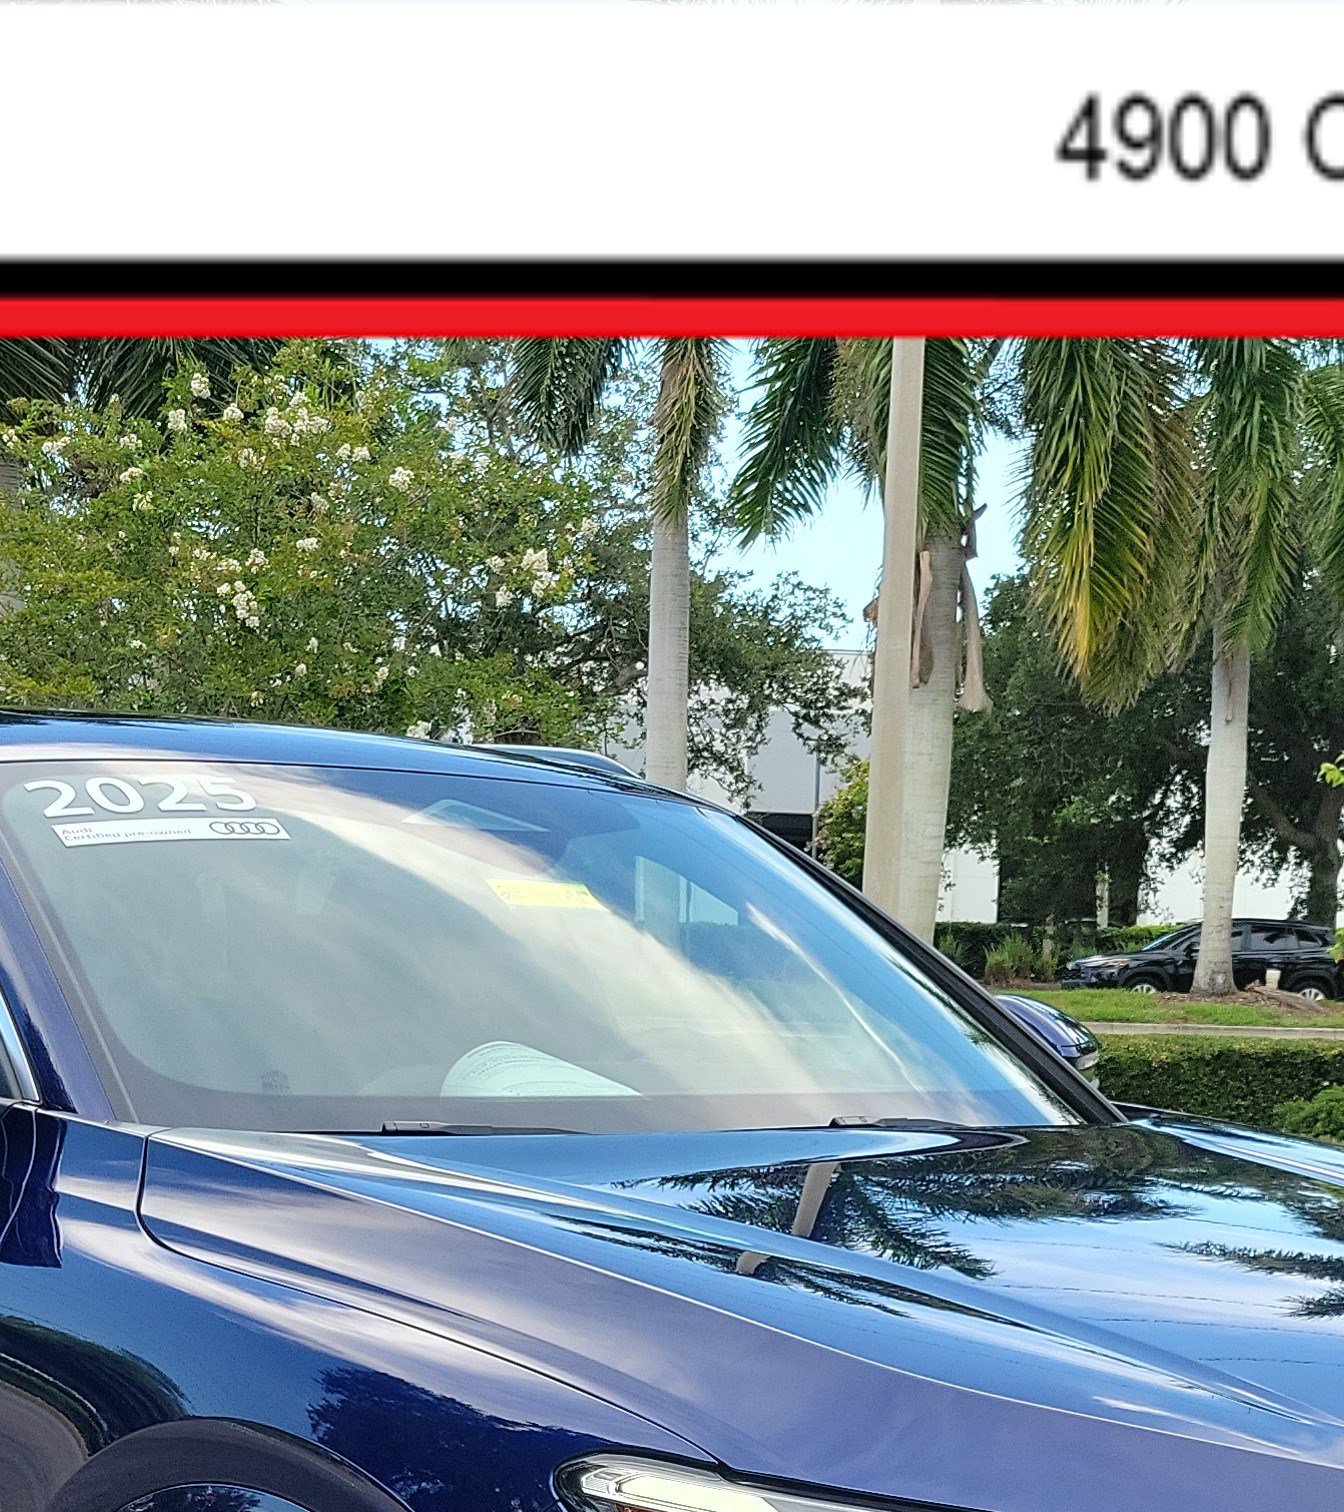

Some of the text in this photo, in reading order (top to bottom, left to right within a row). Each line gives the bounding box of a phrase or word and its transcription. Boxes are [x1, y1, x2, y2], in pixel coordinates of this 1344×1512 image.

[23, 776, 257, 818] 2025
[61, 827, 93, 836] Audi
[64, 828, 192, 842] Certified pre-owned
